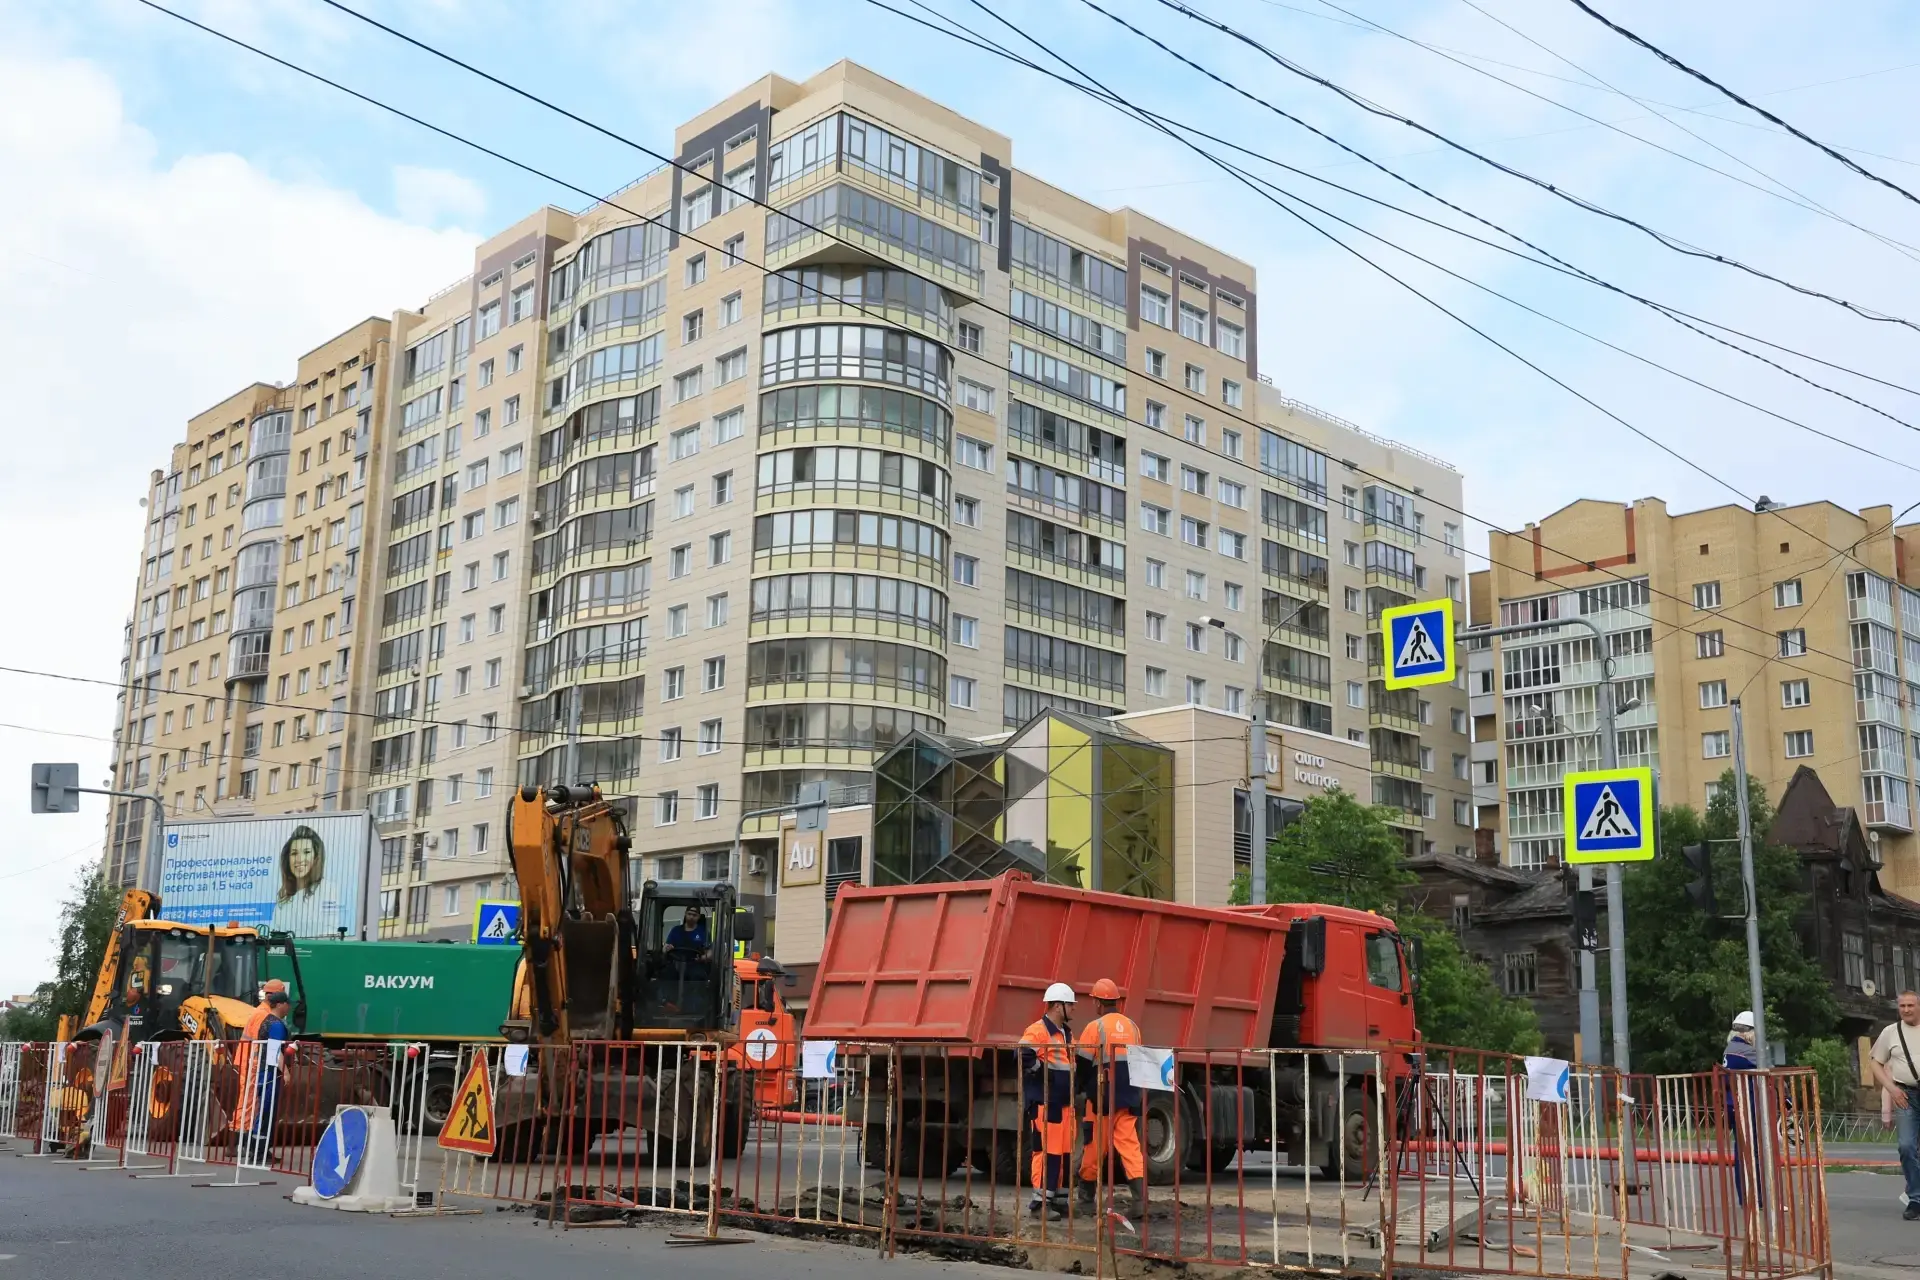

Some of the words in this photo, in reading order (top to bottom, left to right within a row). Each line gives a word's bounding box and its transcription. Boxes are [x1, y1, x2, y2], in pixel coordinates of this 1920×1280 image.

[1294, 751, 1325, 768] aura
[1294, 766, 1340, 792] lounge
[166, 856, 273, 870] Профессиональное
[165, 869, 235, 881] отбеливание
[238, 867, 269, 879] зубов
[164, 883, 194, 893] всего
[196, 883, 208, 891] за
[229, 881, 253, 890] часа
[364, 974, 434, 989] ВАКУУМ
[181, 1012, 198, 1034] JCB
